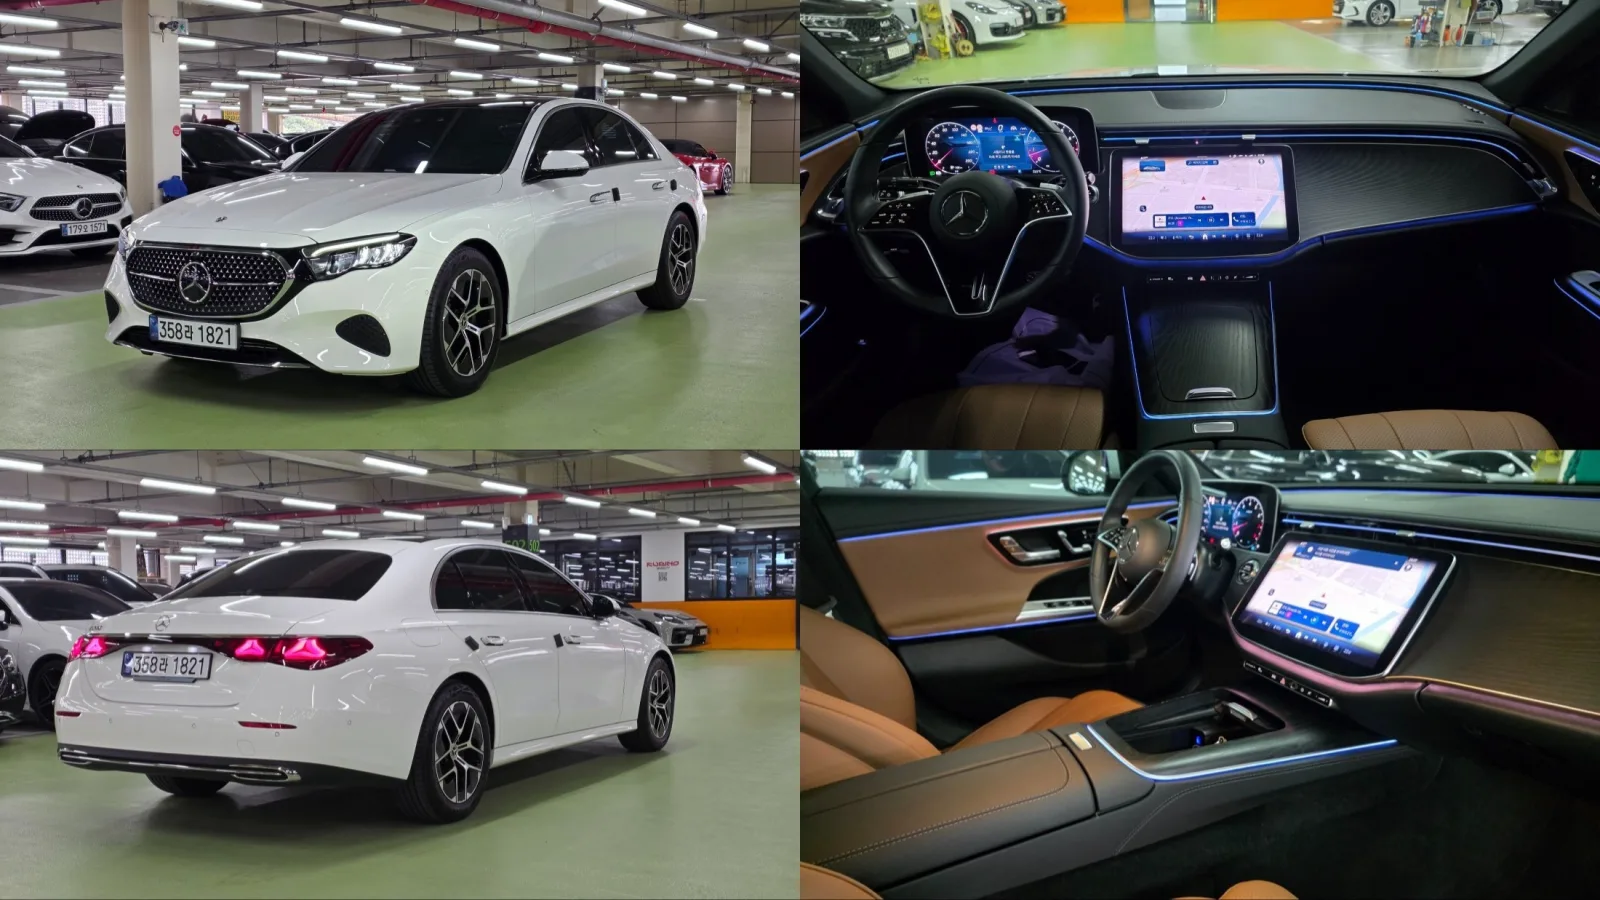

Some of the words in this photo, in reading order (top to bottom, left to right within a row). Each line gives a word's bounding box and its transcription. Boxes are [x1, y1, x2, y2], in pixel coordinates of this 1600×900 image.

[90, 222, 106, 233] 1571
[159, 320, 194, 341] 358라
[197, 324, 231, 346] 1821
[529, 539, 540, 552] 502
[133, 656, 168, 674] 358라
[173, 656, 205, 676] 1821
